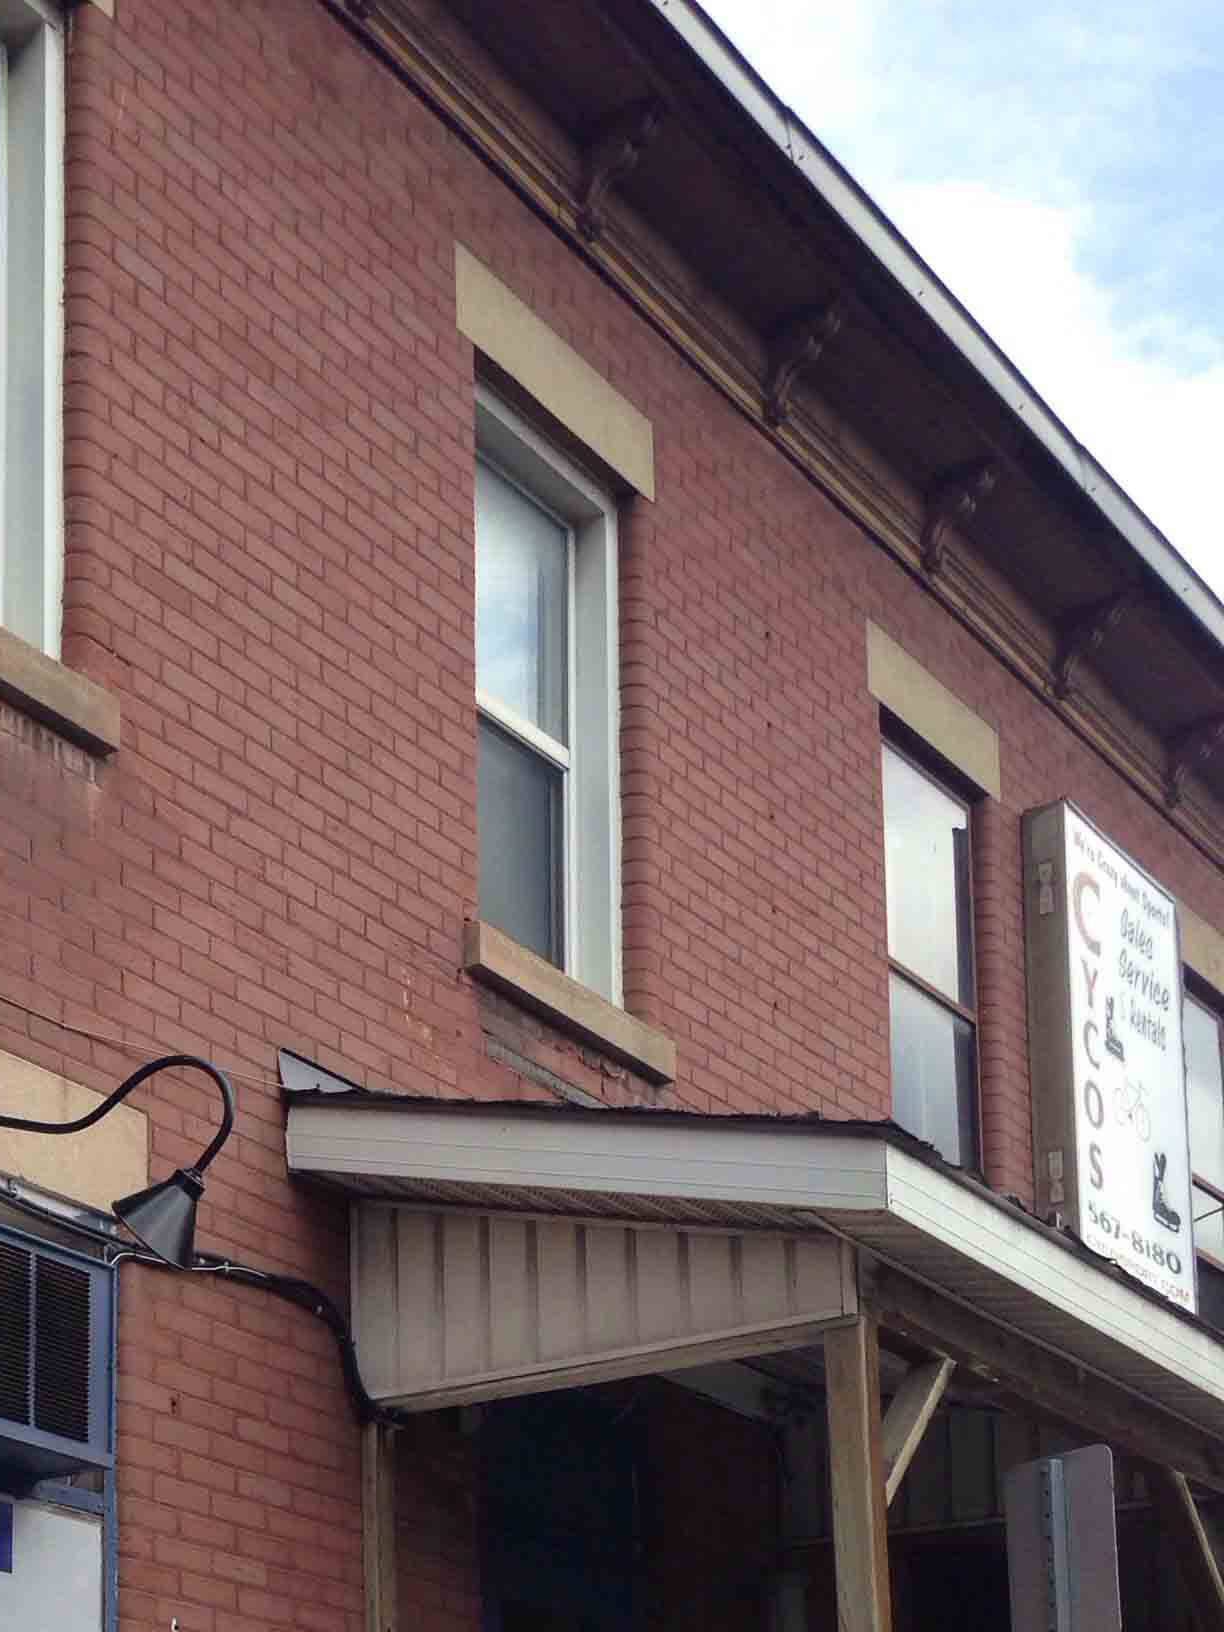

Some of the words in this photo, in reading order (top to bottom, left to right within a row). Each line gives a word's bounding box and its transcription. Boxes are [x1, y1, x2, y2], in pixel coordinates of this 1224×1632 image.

[1120, 907, 1153, 961] Sales
[1118, 948, 1169, 1012] Service
[1088, 1199, 1182, 1275] 567-8180
